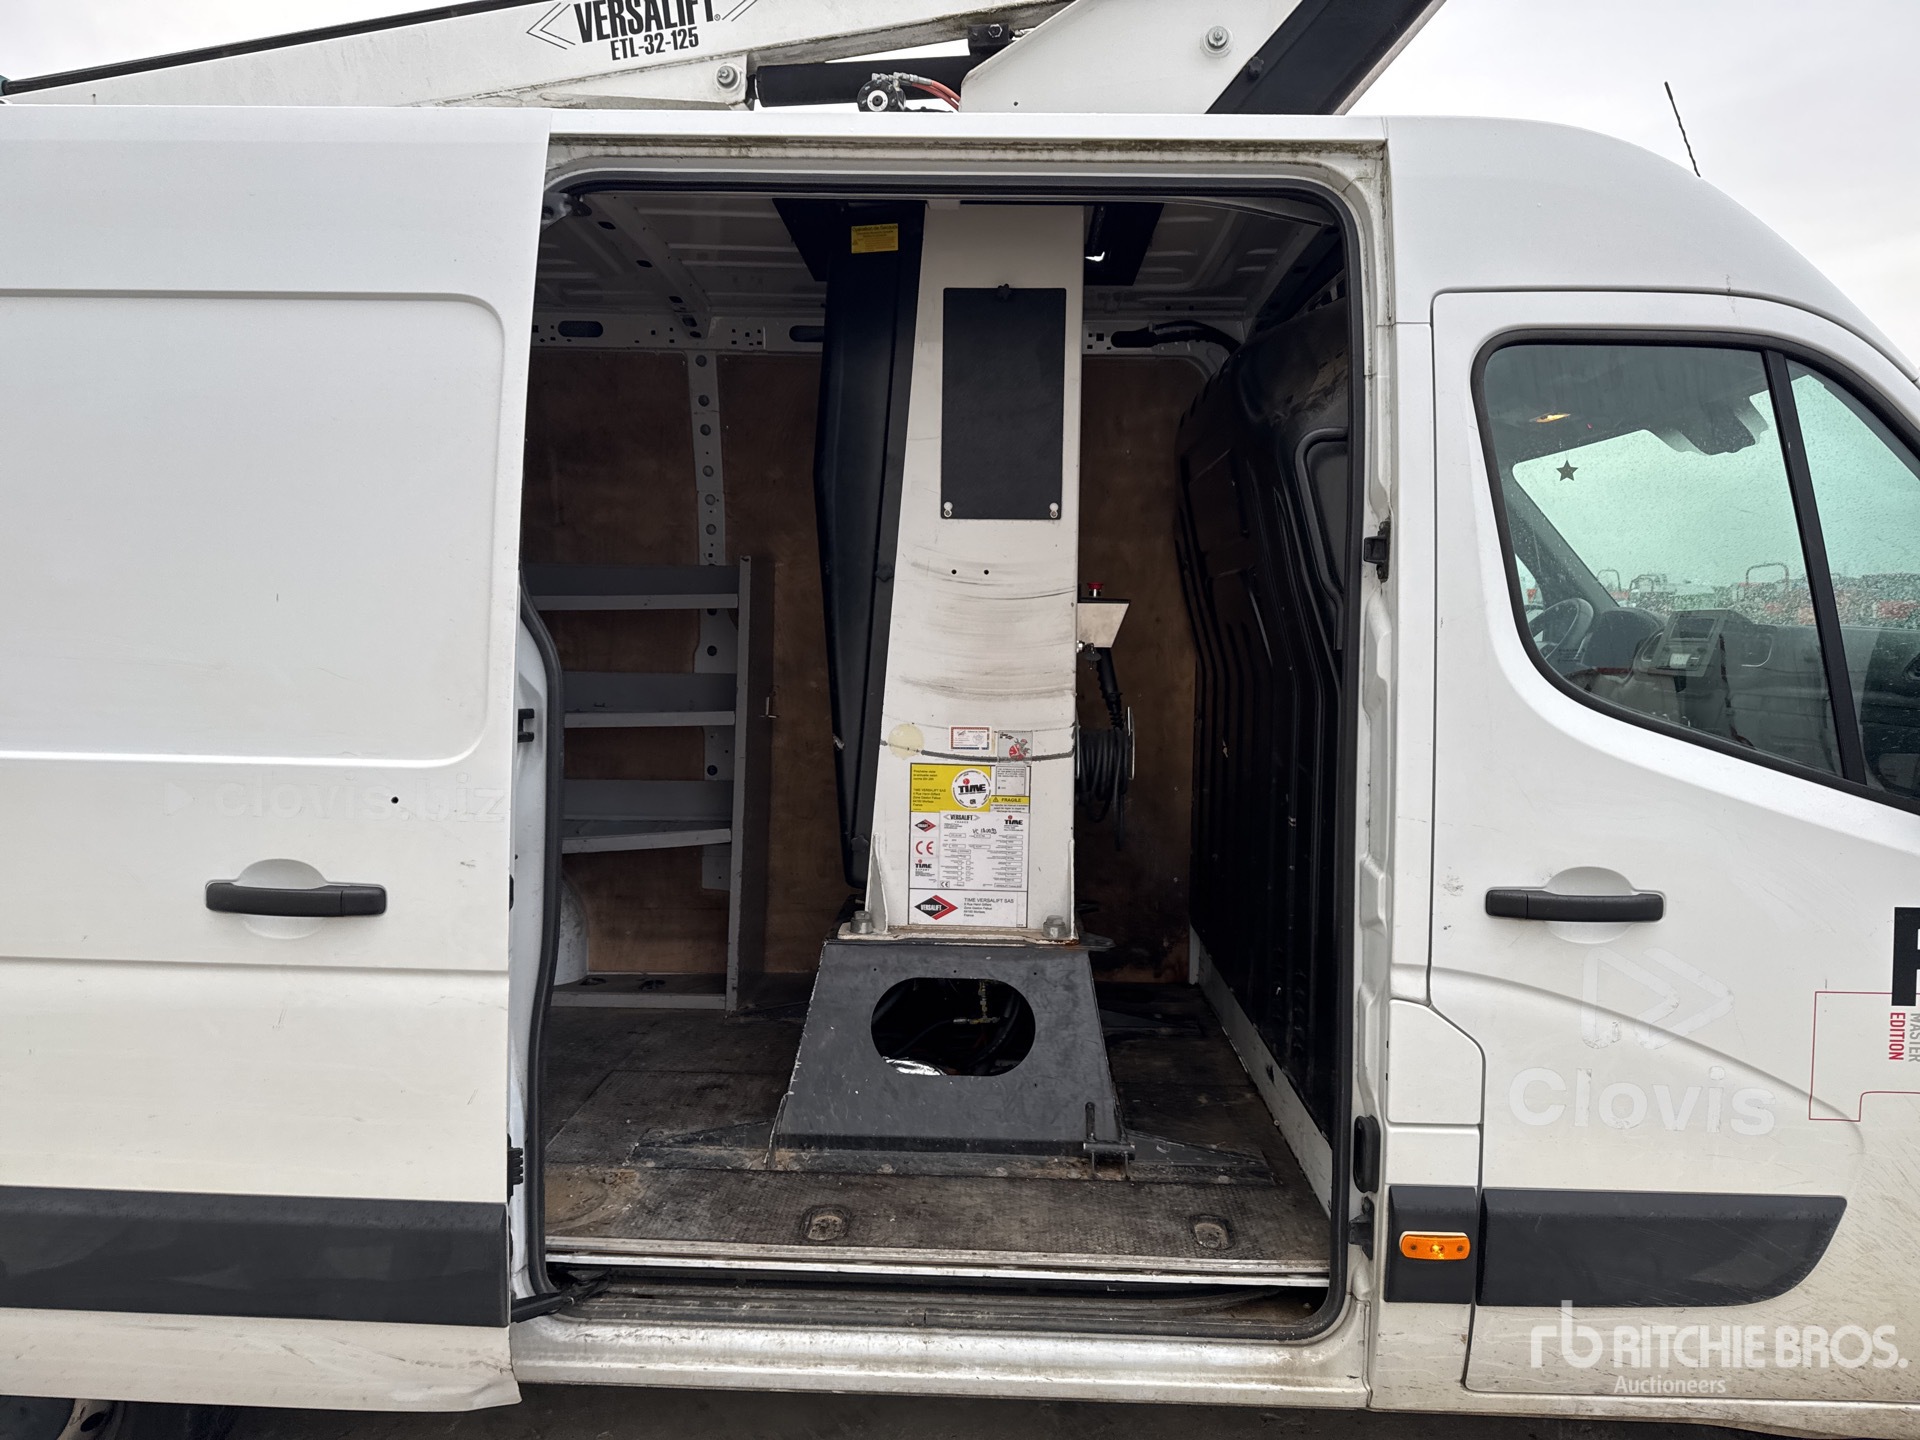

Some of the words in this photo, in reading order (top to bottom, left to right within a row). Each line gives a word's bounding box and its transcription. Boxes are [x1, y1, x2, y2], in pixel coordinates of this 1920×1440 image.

[574, 0, 714, 44] VERSALIFT
[610, 26, 699, 60] ETL-32-125
[958, 778, 986, 793] TIME
[1004, 815, 1023, 825] TIME
[915, 859, 932, 868] TIME
[1889, 1013, 1906, 1060] EDITION
[1908, 1013, 1920, 1062] MASTER
[1509, 1066, 1776, 1136] Clovis
